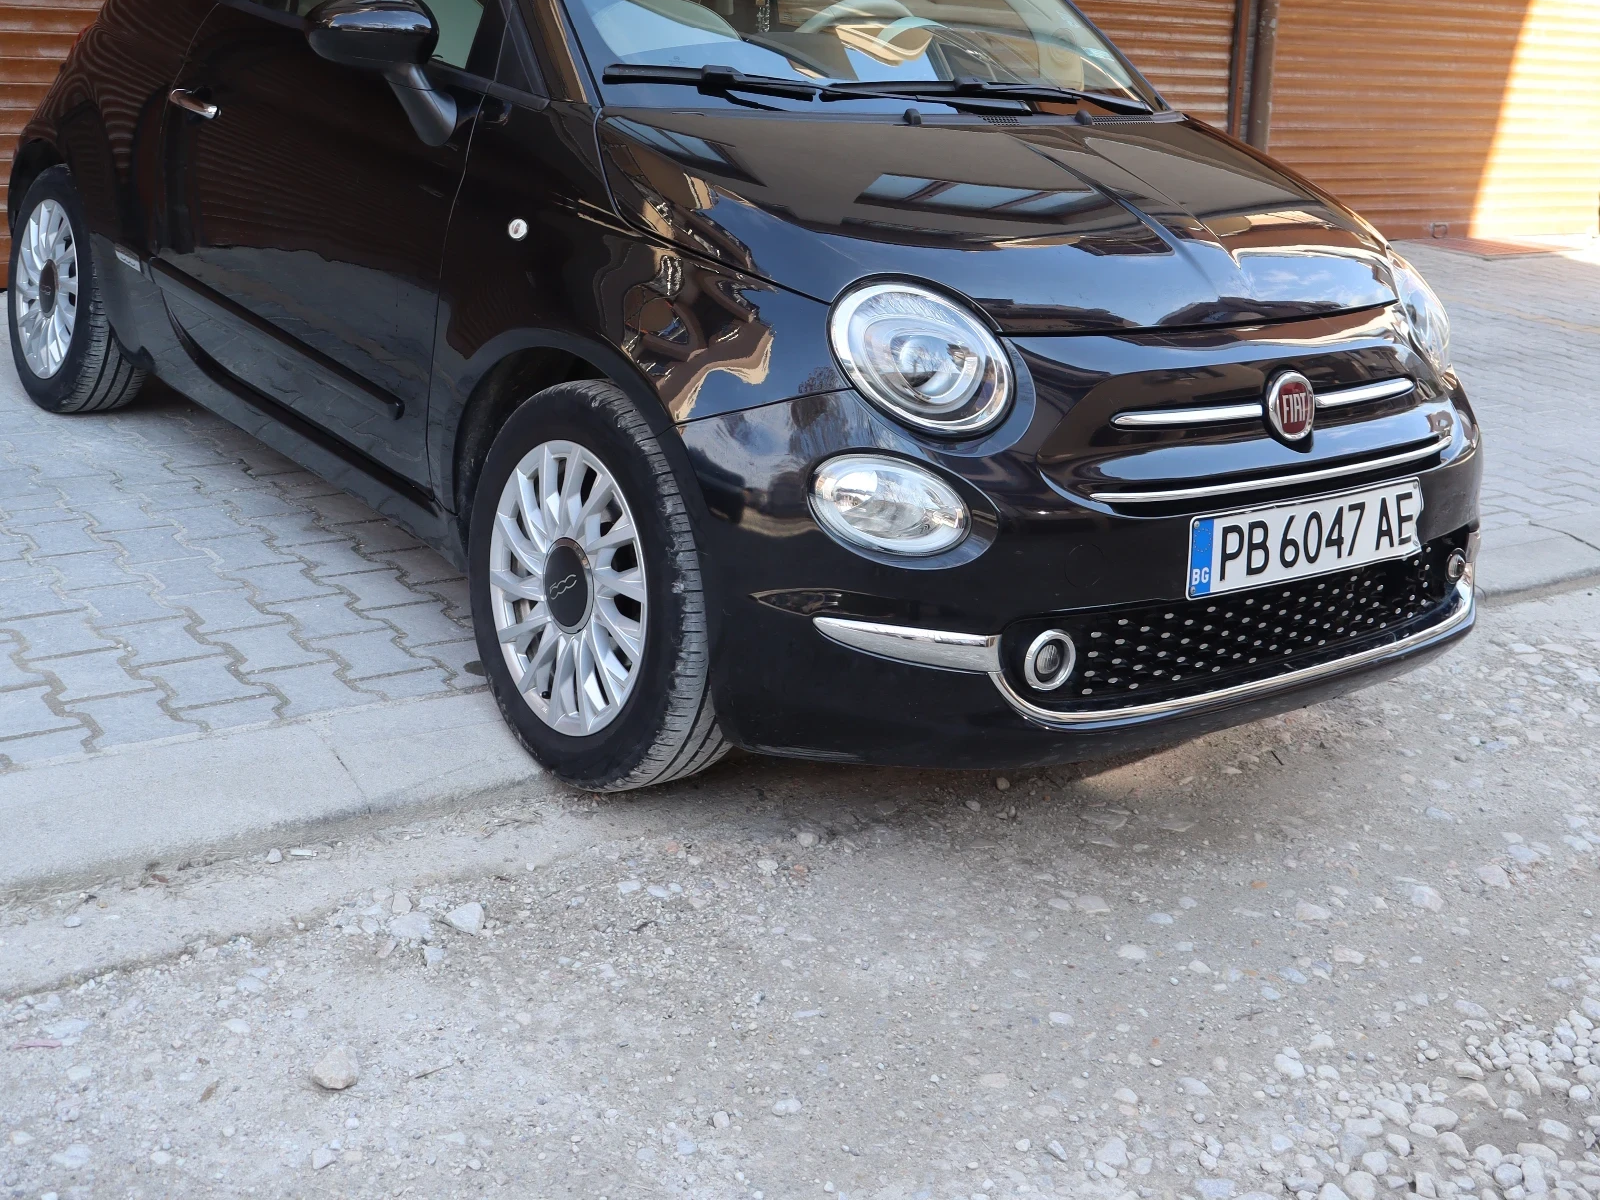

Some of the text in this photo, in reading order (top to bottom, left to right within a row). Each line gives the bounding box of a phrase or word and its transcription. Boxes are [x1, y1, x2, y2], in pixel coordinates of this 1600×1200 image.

[1282, 392, 1307, 424] FIAT
[1219, 491, 1413, 582] PB 6047 AE
[1191, 567, 1210, 586] BG
